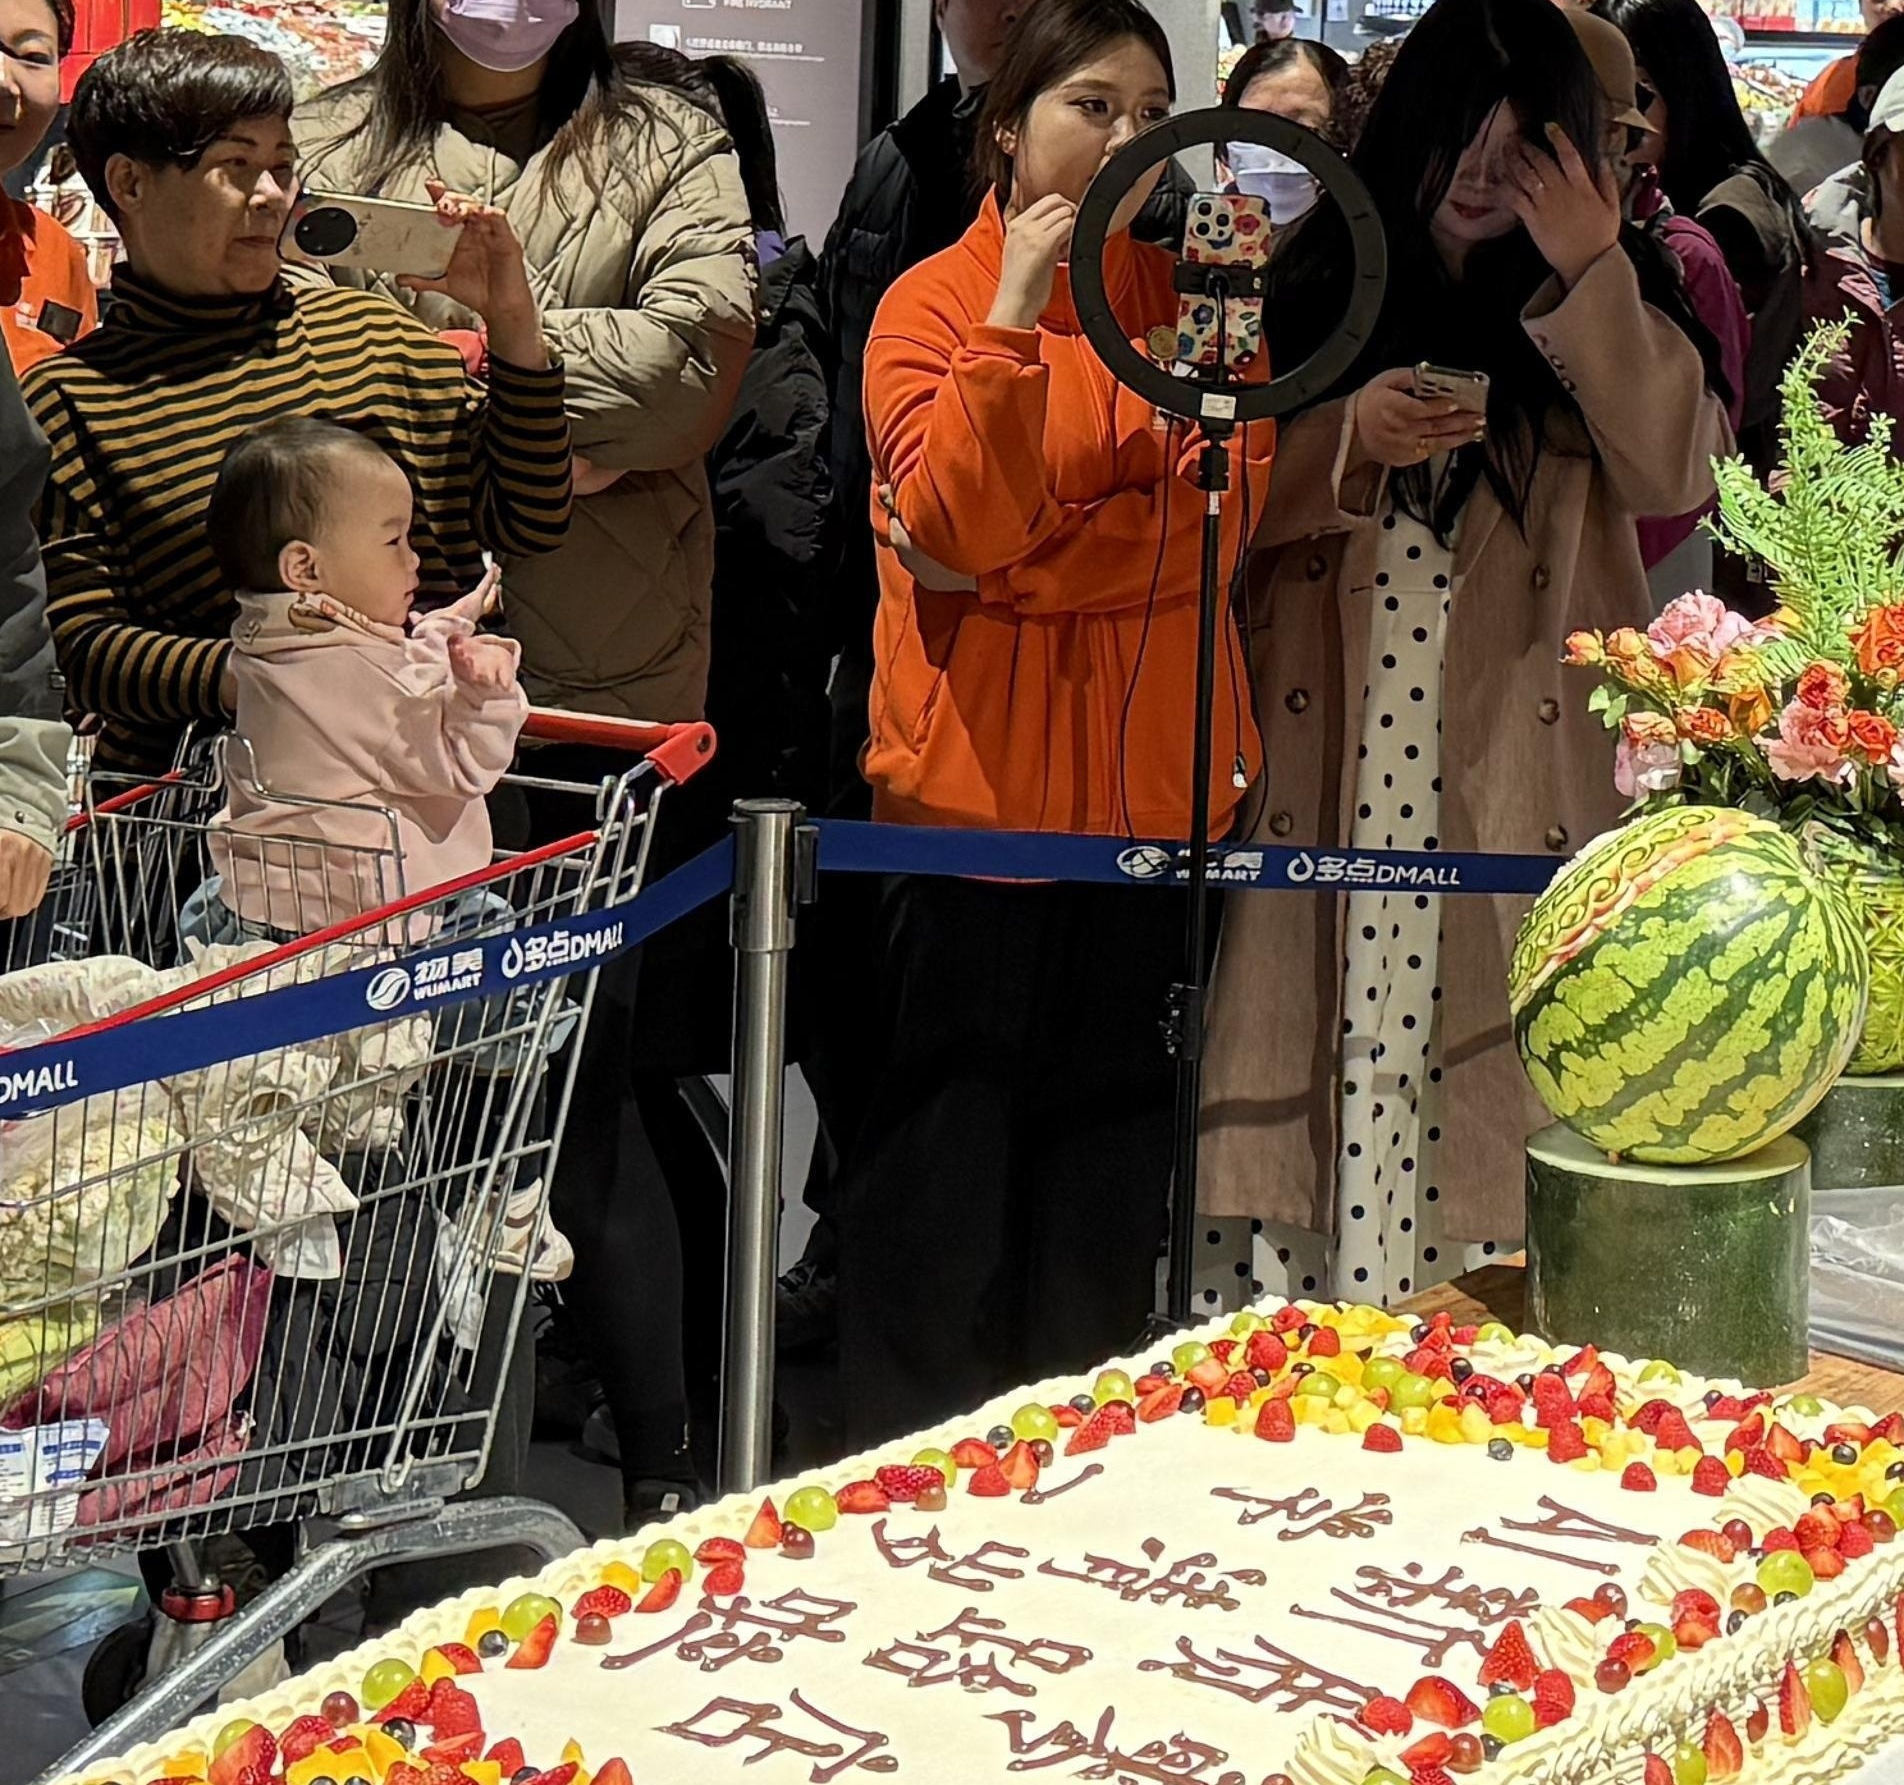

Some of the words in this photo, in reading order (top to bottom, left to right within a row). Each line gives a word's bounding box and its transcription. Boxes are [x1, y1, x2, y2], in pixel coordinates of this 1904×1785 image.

[1175, 869, 1261, 882] WMART
[414, 947, 484, 985] 物美
[413, 972, 482, 1001] WUMART
